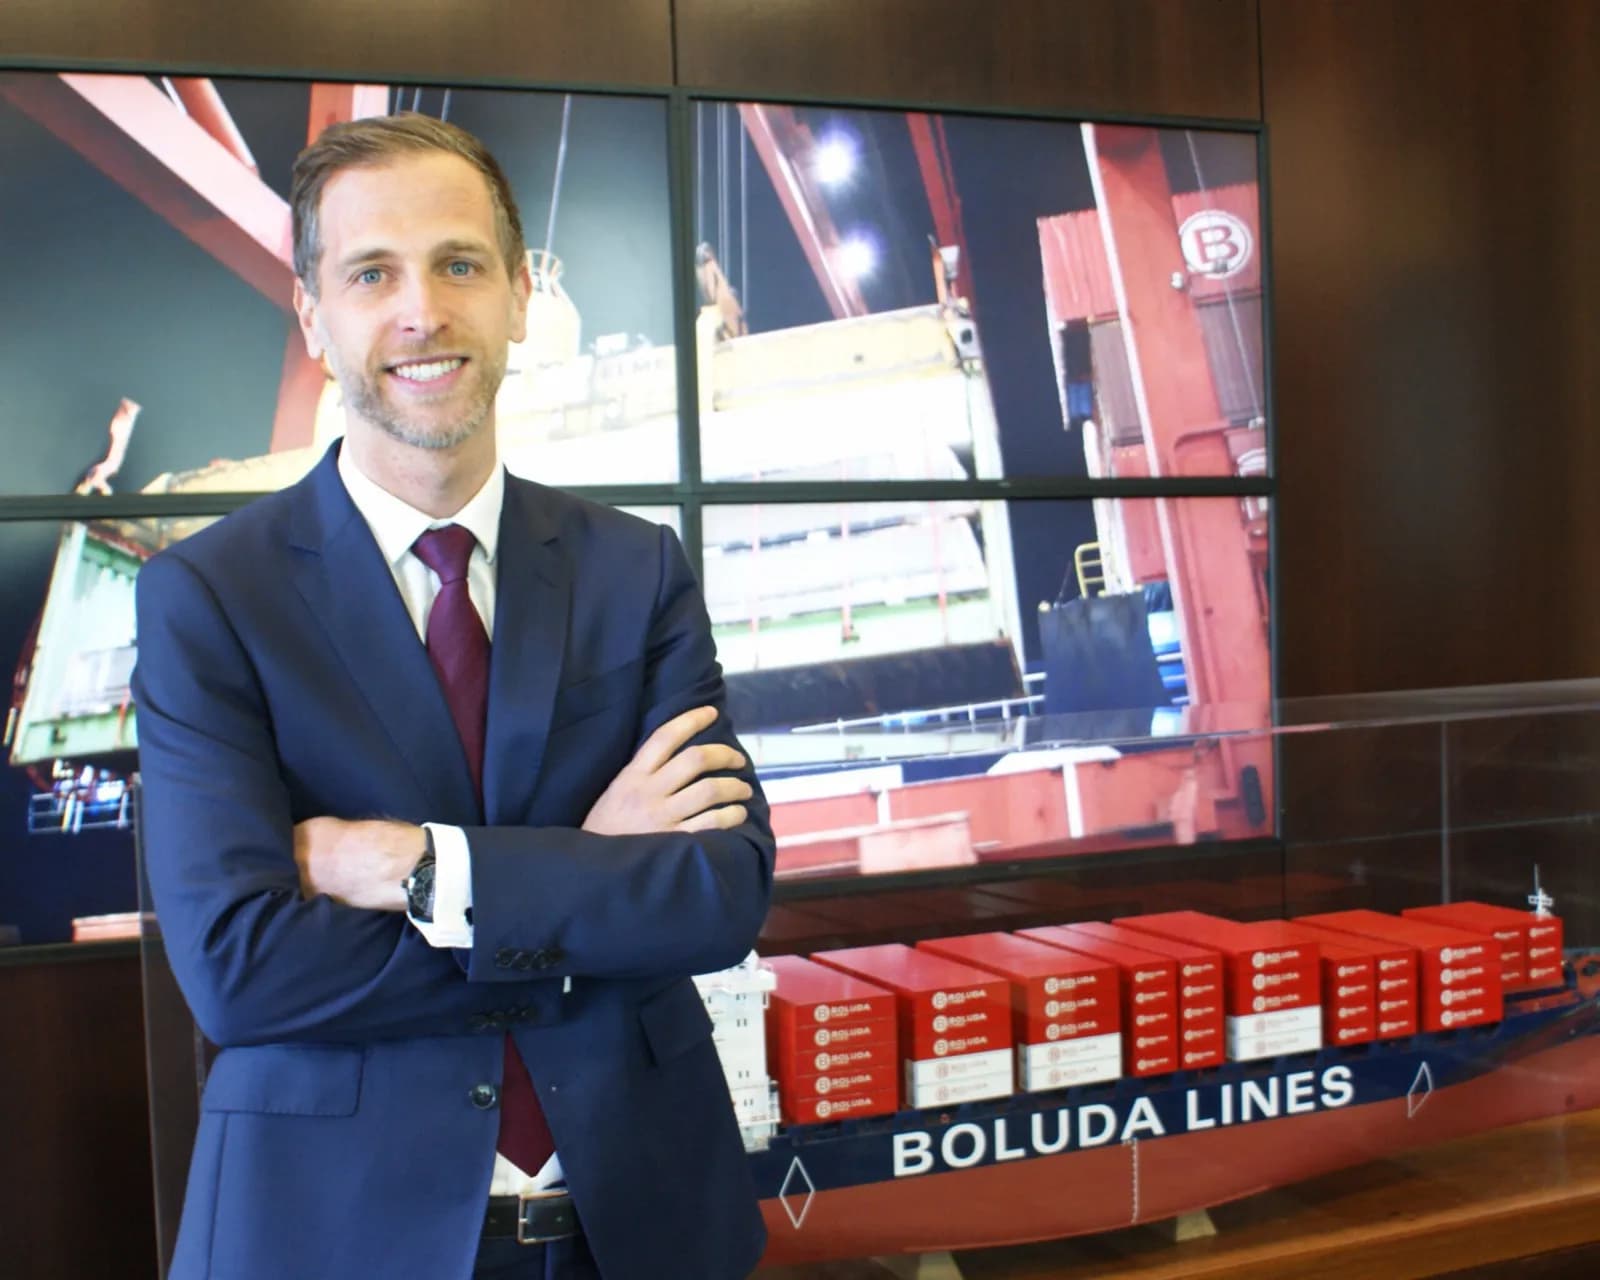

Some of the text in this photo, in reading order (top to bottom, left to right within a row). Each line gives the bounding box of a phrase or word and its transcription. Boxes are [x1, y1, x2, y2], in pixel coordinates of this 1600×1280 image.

[1194, 225, 1239, 264] B
[893, 1065, 1354, 1177] BOLUDA LINES
